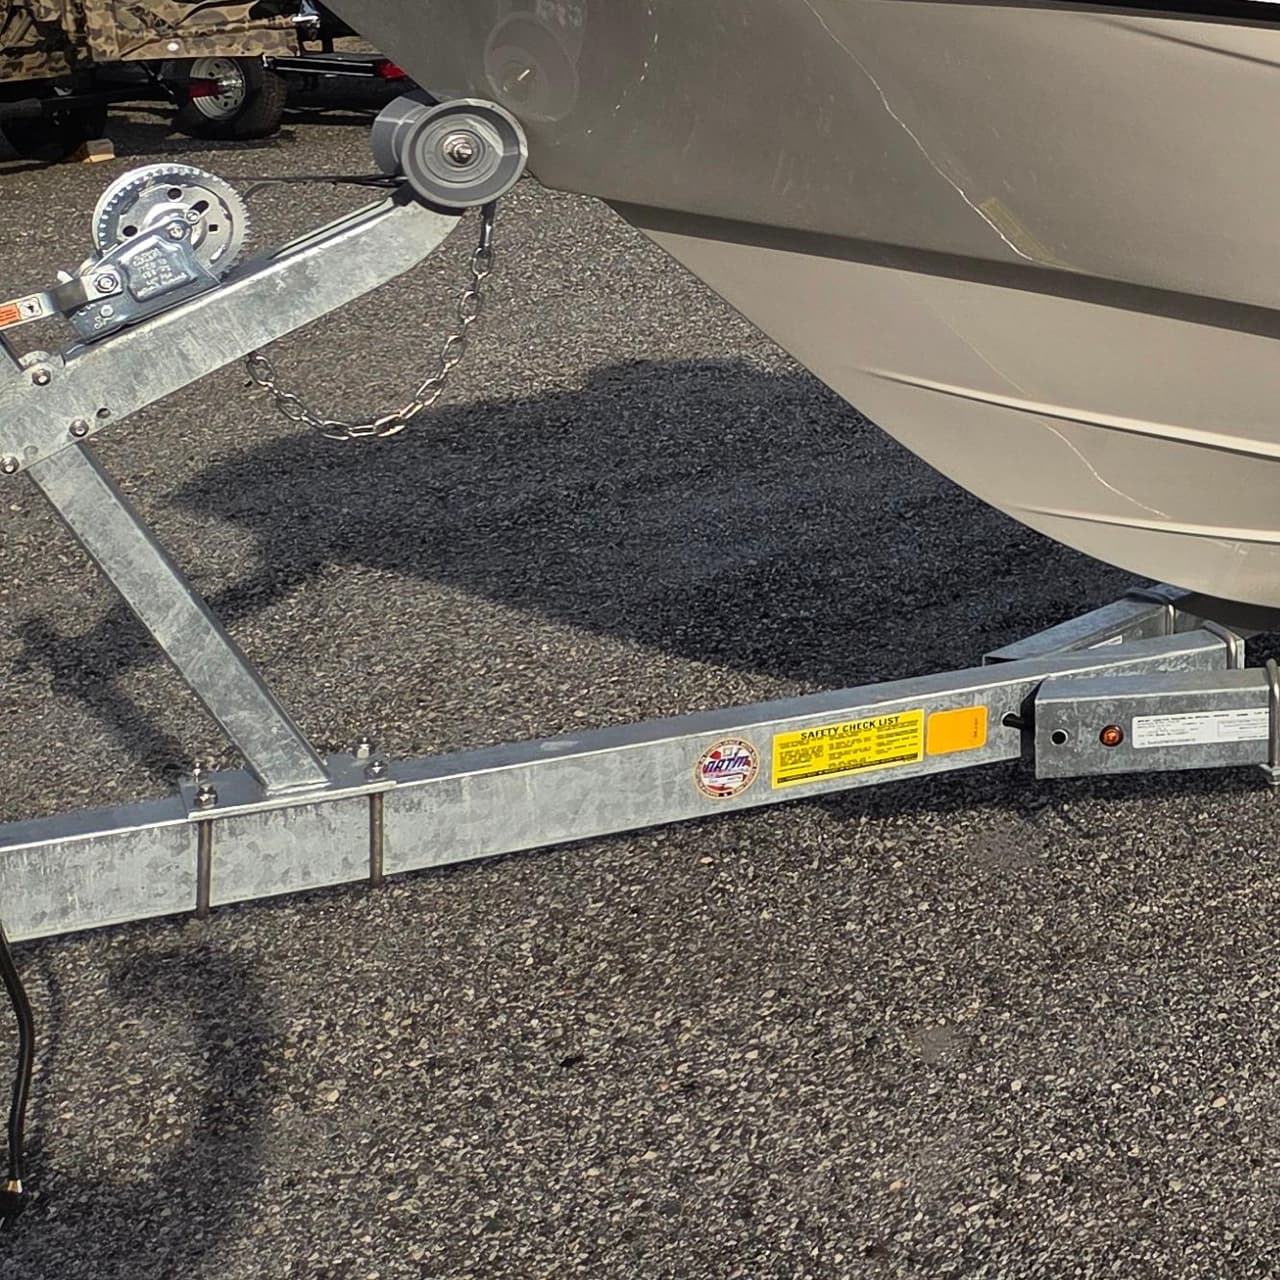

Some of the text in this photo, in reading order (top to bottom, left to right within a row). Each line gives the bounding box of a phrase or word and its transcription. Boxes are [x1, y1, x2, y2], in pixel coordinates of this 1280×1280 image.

[800, 716, 901, 740] SAFETY CHECK LIST
